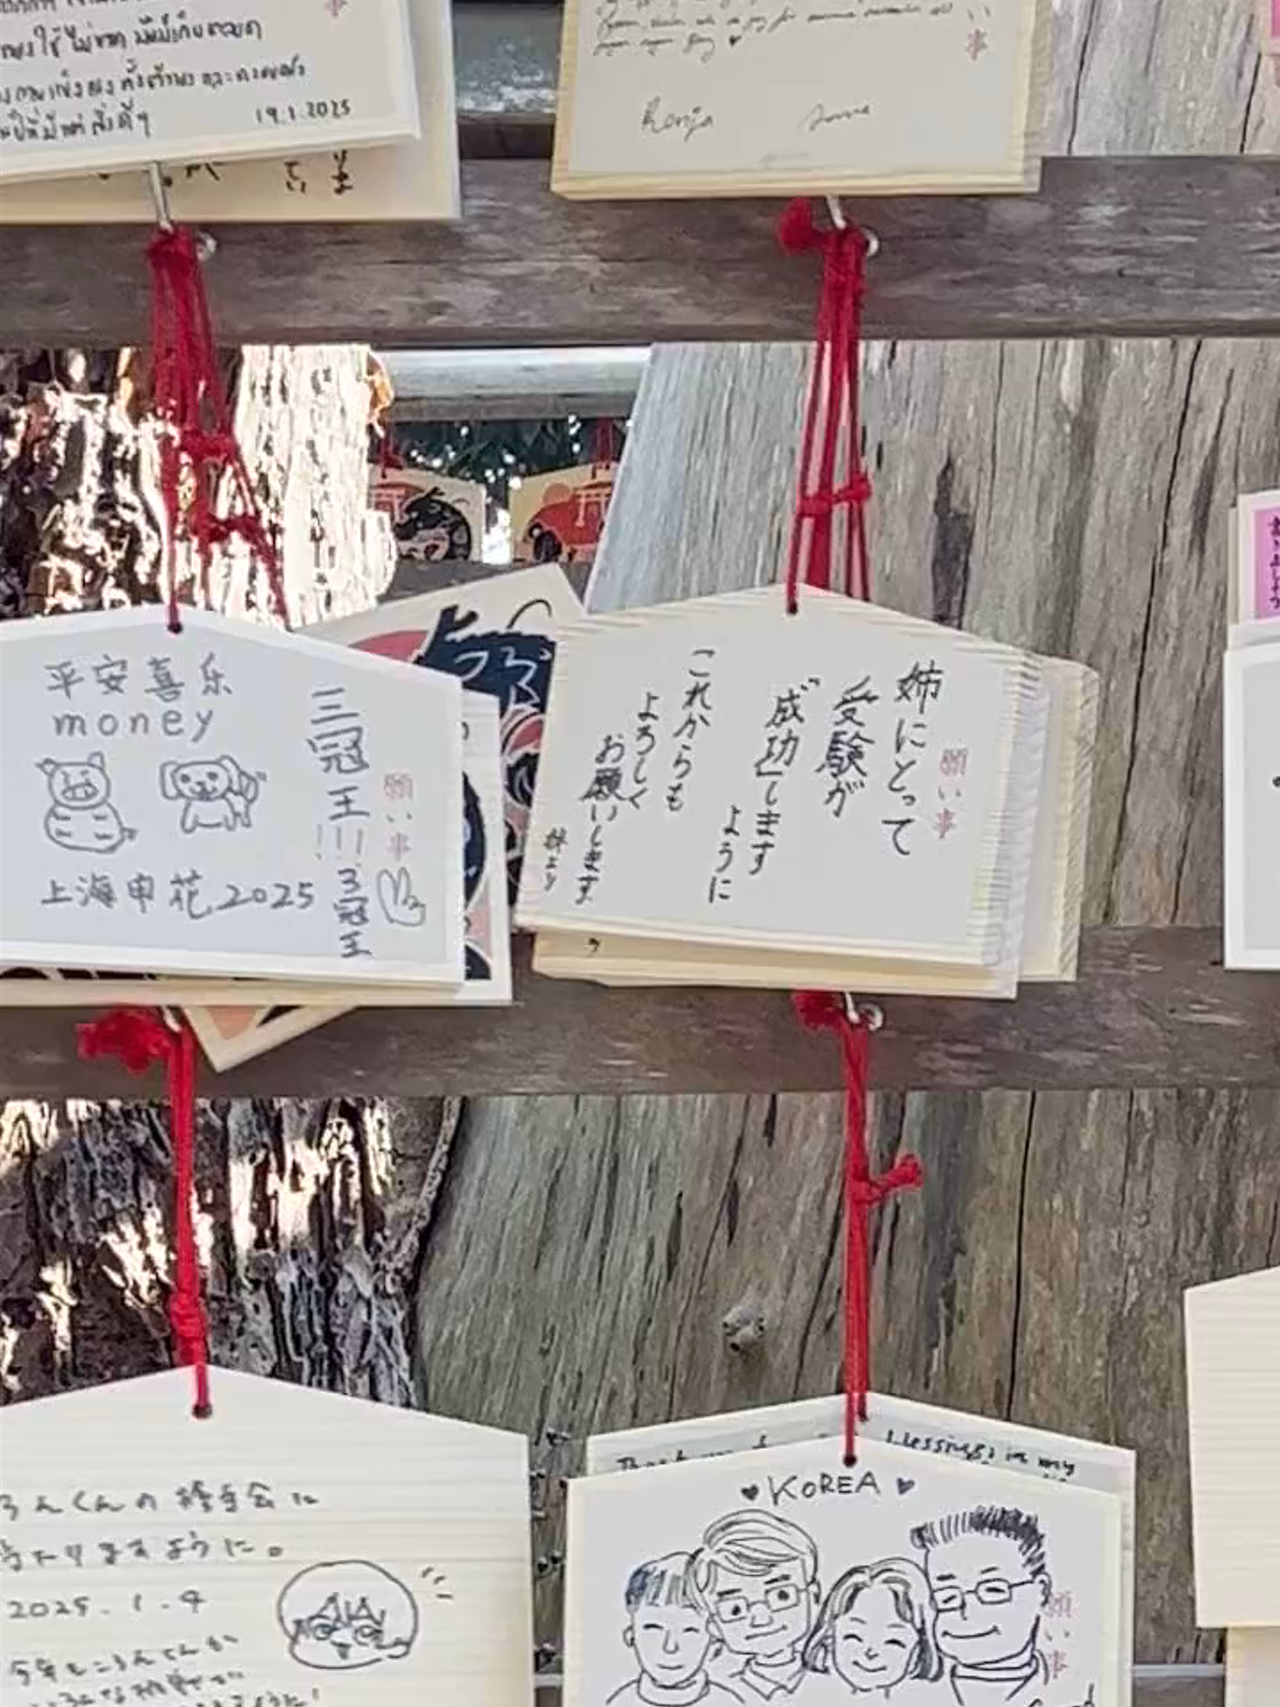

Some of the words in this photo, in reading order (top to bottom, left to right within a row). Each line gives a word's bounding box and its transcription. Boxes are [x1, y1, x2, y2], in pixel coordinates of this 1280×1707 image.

[45, 652, 233, 701] 平安喜乐
[53, 708, 215, 744] money
